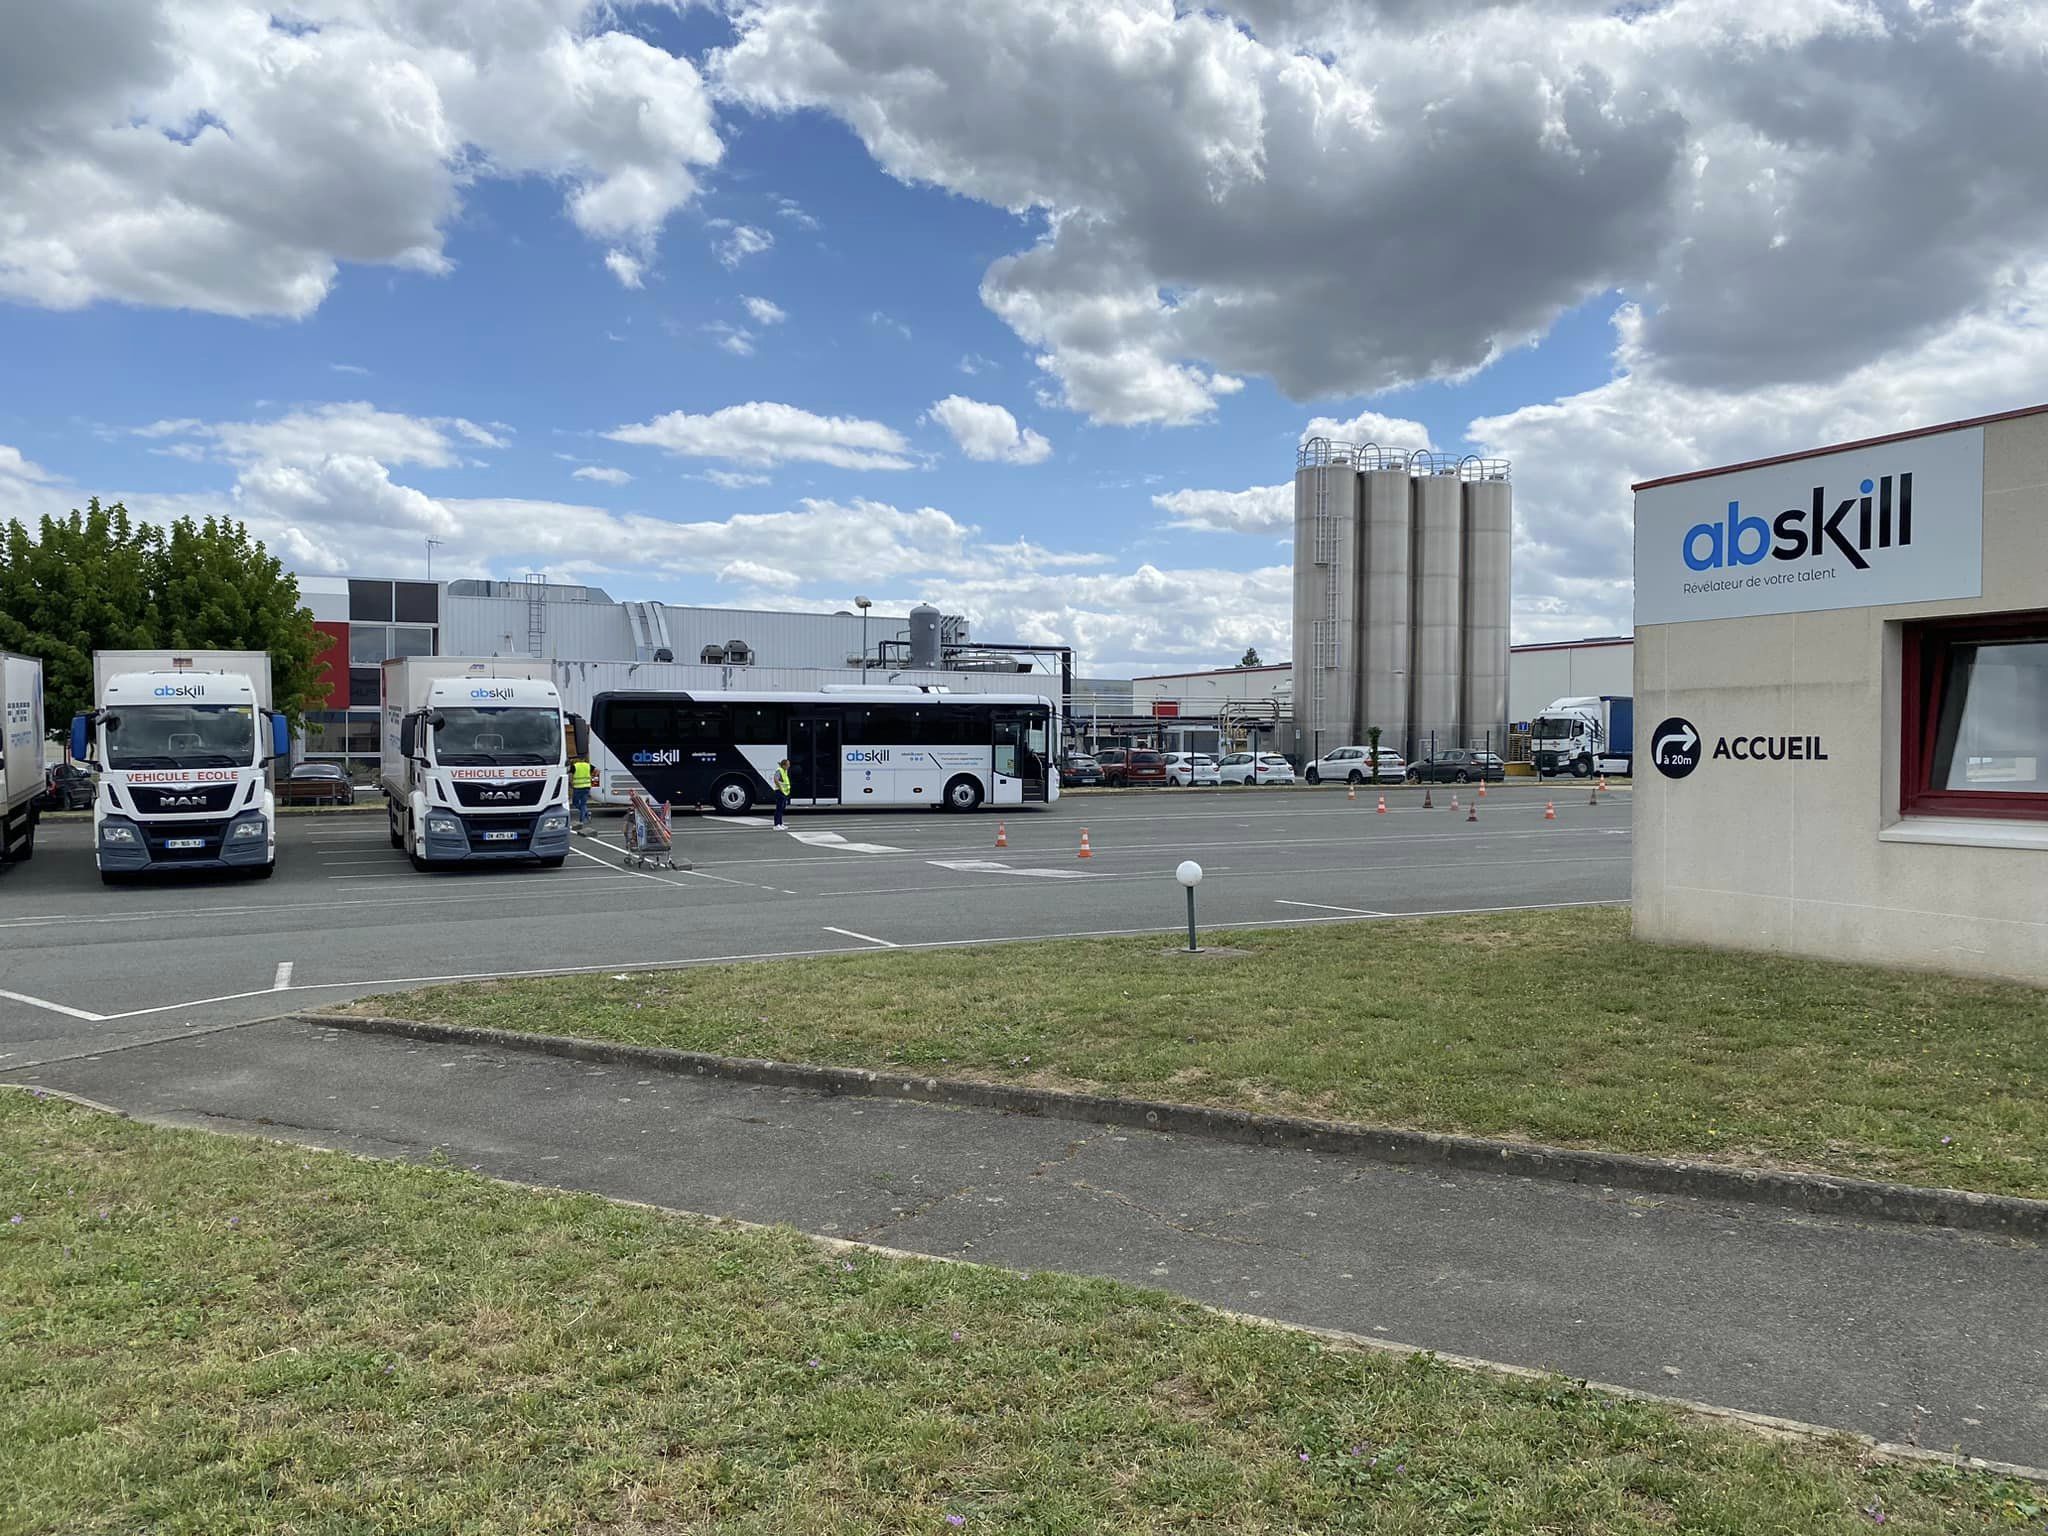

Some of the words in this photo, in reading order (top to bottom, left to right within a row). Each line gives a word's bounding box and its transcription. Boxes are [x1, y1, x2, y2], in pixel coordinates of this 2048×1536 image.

[1682, 471, 1912, 572] abskill
[1683, 578, 1743, 594] Révélateur
[1746, 576, 1761, 588] de
[1763, 572, 1795, 586] votre
[1797, 568, 1836, 583] talent
[154, 684, 205, 699] abskill
[470, 687, 514, 701] abskill
[1712, 736, 1828, 761] ACCUEIL
[632, 749, 680, 766] abskill
[846, 749, 890, 765] abskill
[1663, 754, 1670, 765] à
[1671, 754, 1692, 765] 20m
[126, 771, 190, 783] VEHICULE
[197, 770, 239, 781] ECOLE
[450, 769, 505, 779] VEHICULE
[512, 768, 548, 778] ECOLE
[159, 795, 207, 807] MAN
[479, 790, 521, 800] MAN
